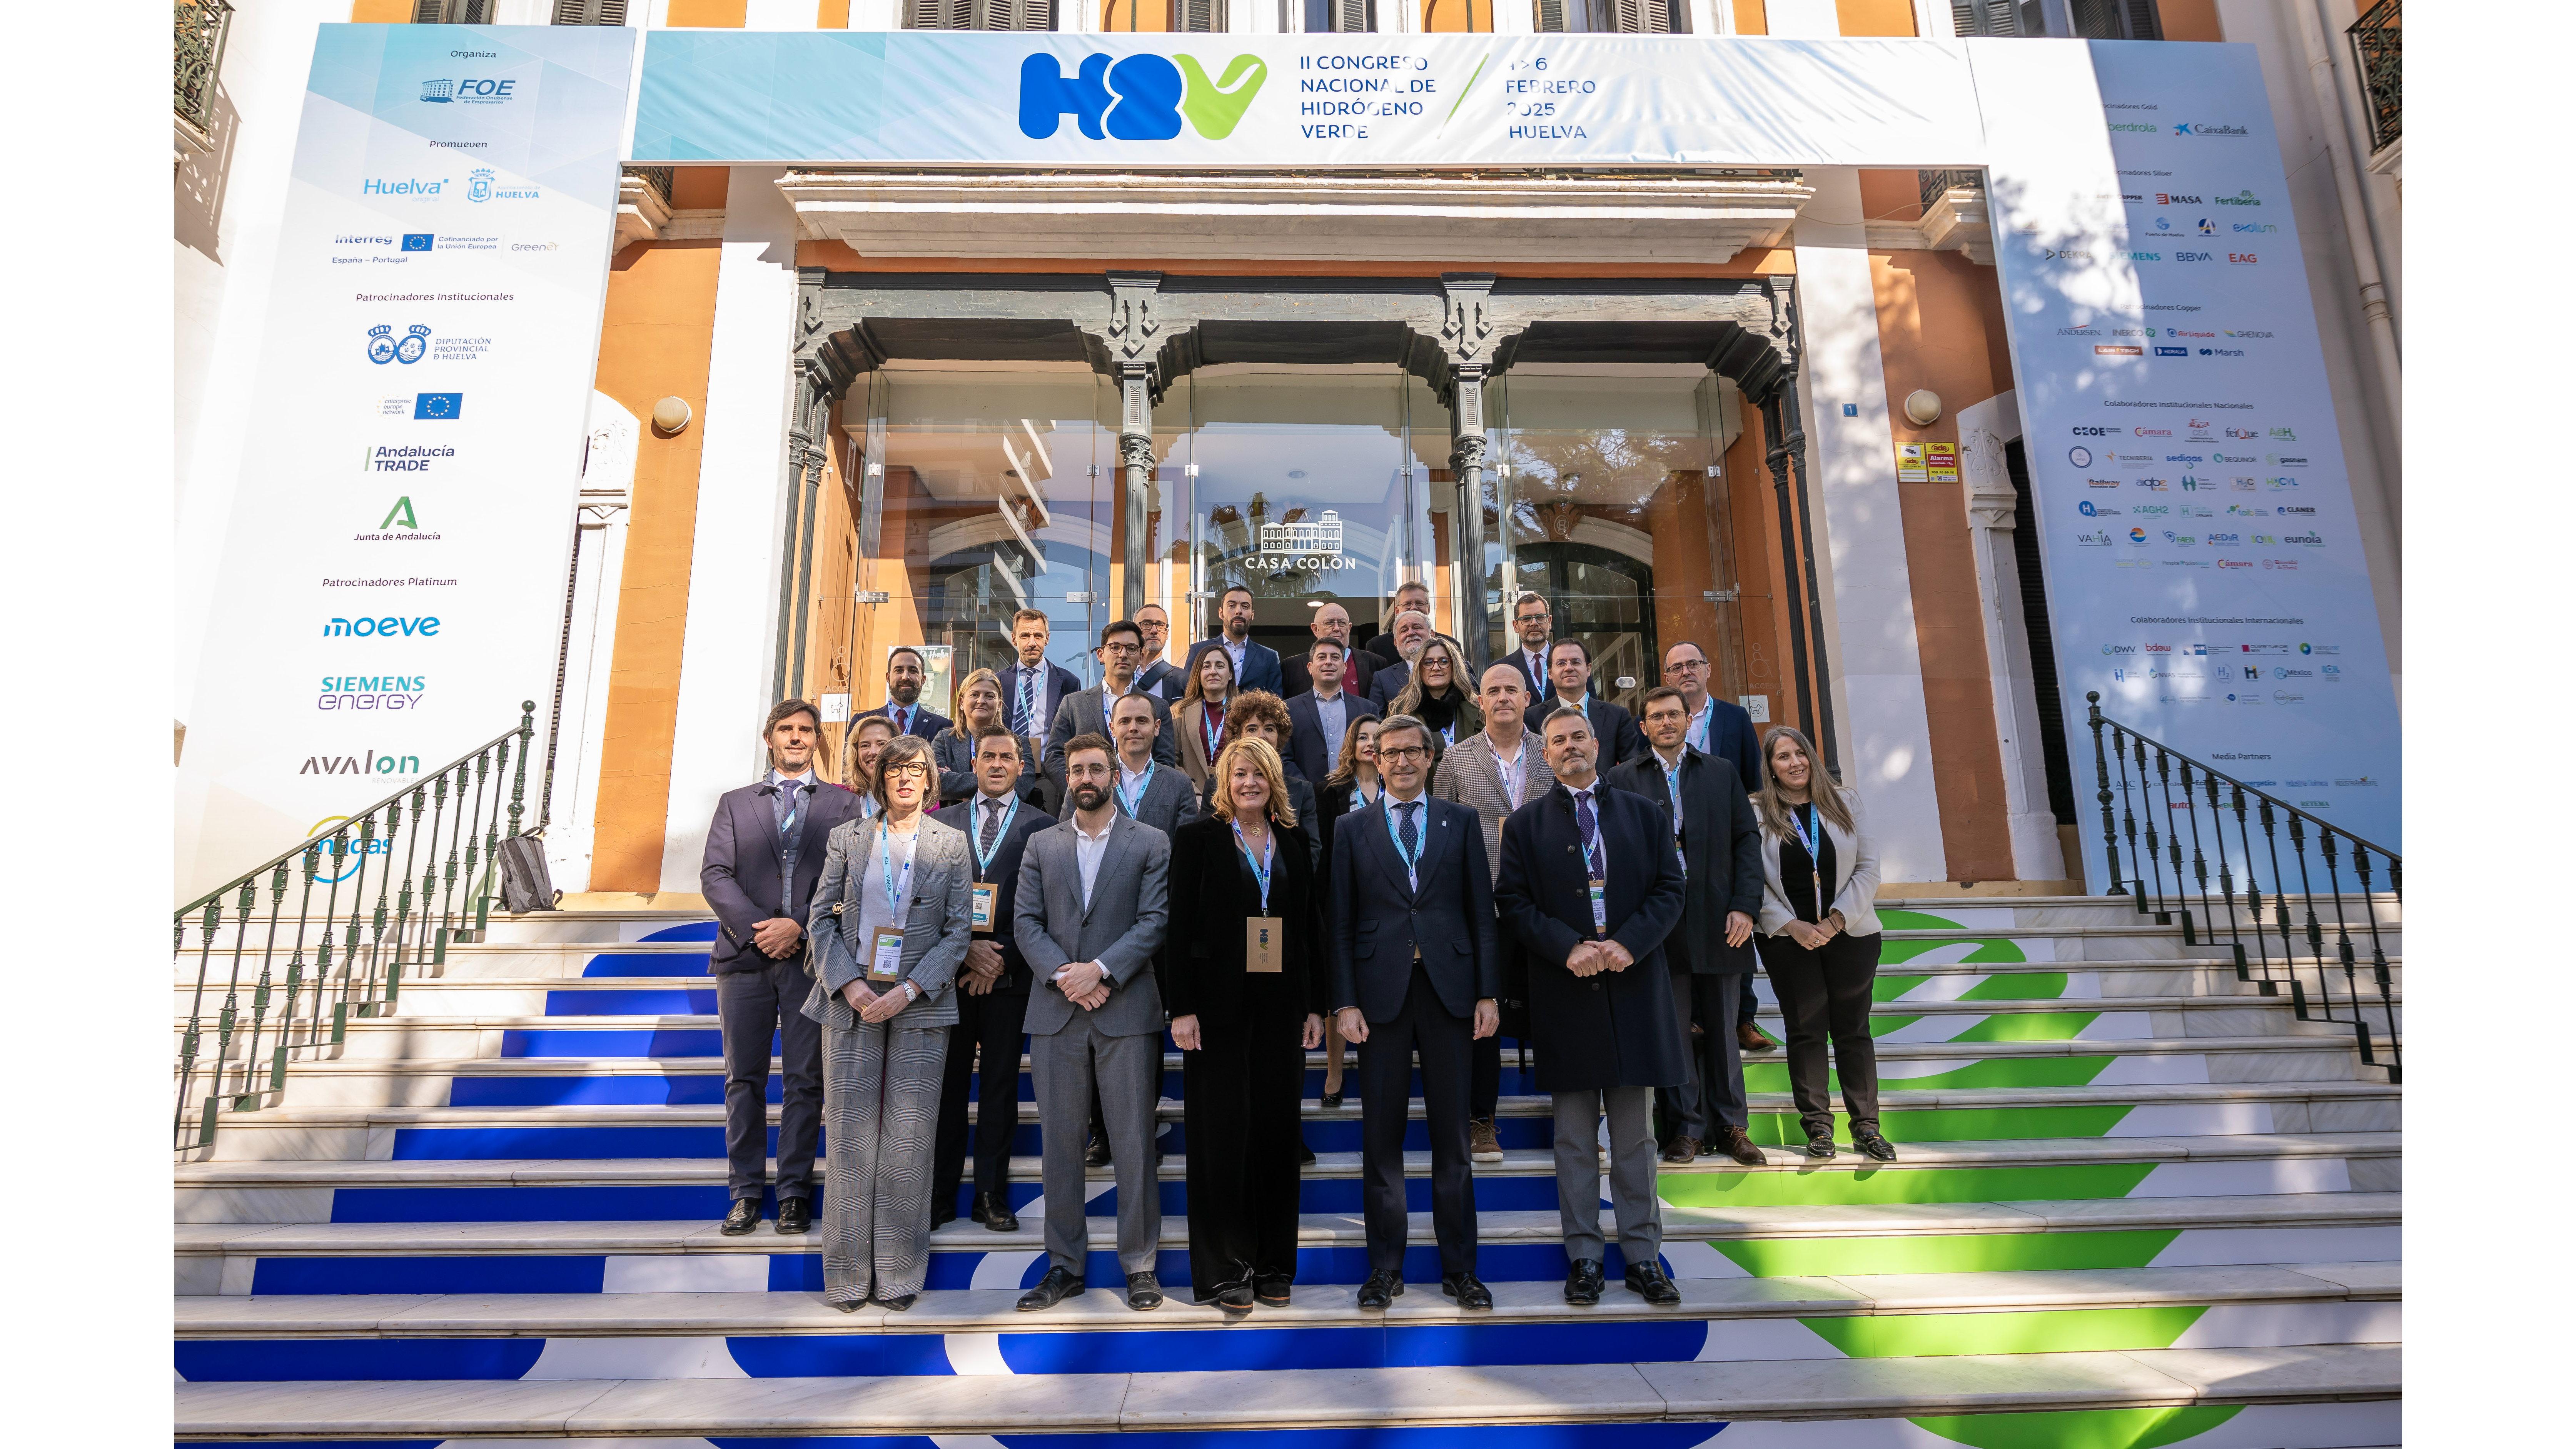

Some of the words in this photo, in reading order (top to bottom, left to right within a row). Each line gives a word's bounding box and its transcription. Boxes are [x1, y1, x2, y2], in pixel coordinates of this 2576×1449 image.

[450, 50, 496, 59] Organiza
[1301, 57, 1311, 72] II
[1317, 56, 1428, 72] CONGRESO
[1536, 58, 1547, 70] 6
[458, 79, 516, 95] FOE
[1301, 78, 1407, 93] NACIONAL
[1411, 78, 1436, 93] DE
[1506, 80, 1596, 93] FEBRERO
[1301, 97, 1423, 117] HIDRÓGENO
[1507, 102, 1555, 116] 2025
[1301, 124, 1369, 139] VERDE
[1509, 125, 1587, 139] HUELVA
[2195, 124, 2249, 135] CaixaBank
[364, 179, 441, 195] Huelva
[2171, 195, 2203, 204] MASA
[2215, 197, 2262, 206] Fertiberia
[336, 234, 392, 245] Interreg
[2060, 250, 2093, 259] DEKRA
[2110, 251, 2161, 261] SIEMENS
[2176, 252, 2213, 262] BBVA
[2228, 253, 2258, 263] EAG
[438, 293, 514, 301] Institucionales
[1848, 405, 1853, 414] 1
[2073, 427, 2106, 436] CEOE
[2135, 427, 2172, 437] Cámara
[376, 445, 455, 457] Andalucía
[375, 461, 430, 471] TRADE
[2142, 506, 2169, 514] AGH2
[396, 532, 441, 540] Andalucía
[1245, 557, 1292, 569] CASA
[2218, 559, 2253, 569] Cámara
[322, 578, 405, 587] Patrocinadores
[408, 578, 457, 586] Platinum
[324, 617, 440, 637] moeve
[2145, 643, 2171, 651] bdew
[321, 676, 426, 692] SIEMENS
